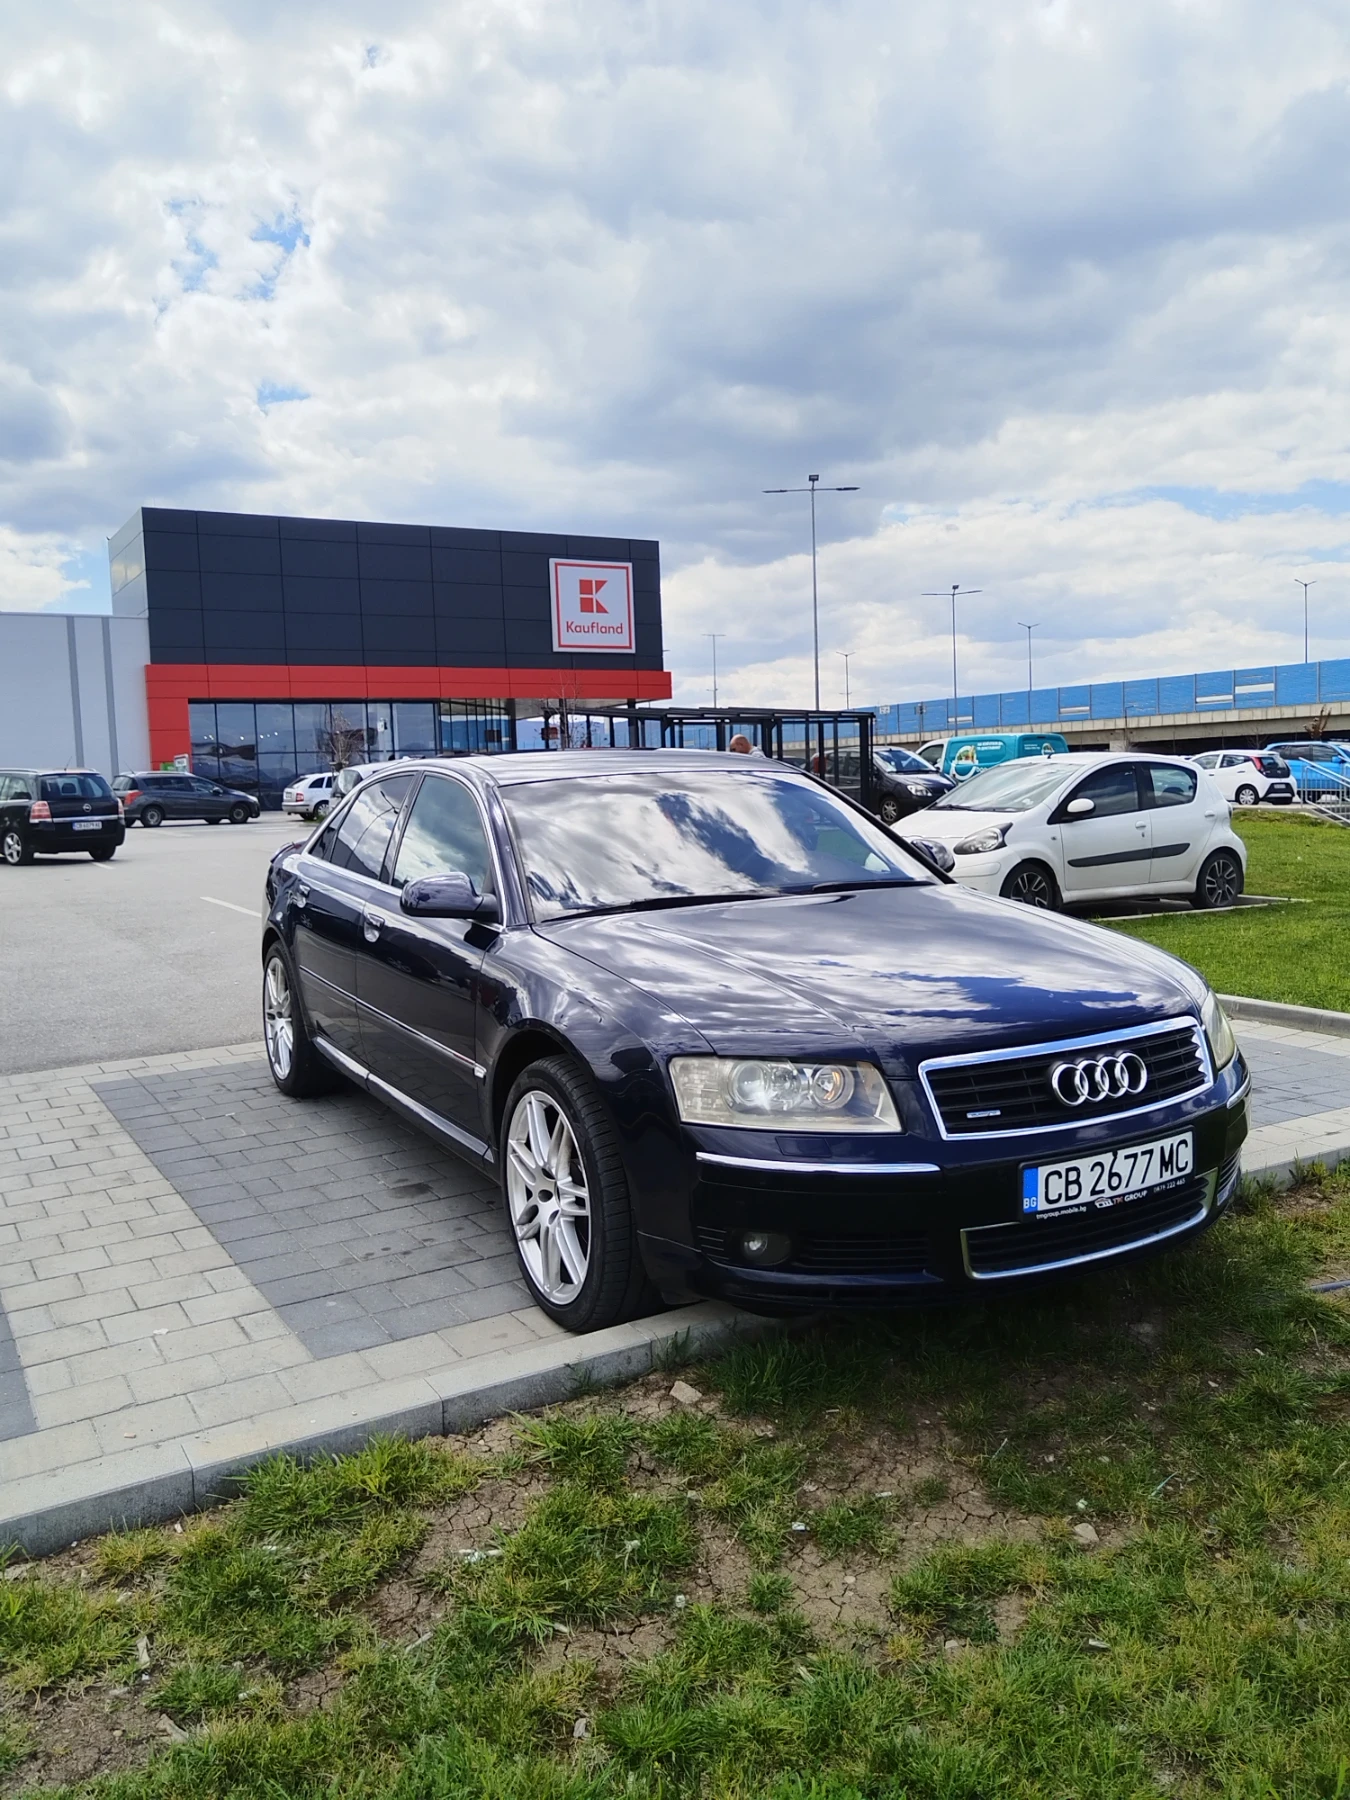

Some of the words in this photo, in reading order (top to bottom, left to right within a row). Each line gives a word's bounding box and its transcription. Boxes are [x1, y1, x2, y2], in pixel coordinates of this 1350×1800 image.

[579, 579, 609, 614] K
[566, 621, 624, 635] Kaufland
[1044, 1166, 1083, 1204] CB
[1090, 1149, 1154, 1197] 2677
[1159, 1139, 1189, 1179] MC
[1023, 1196, 1037, 1209] BG
[1036, 1205, 1087, 1220] tmgroup.mobile.bg
[1124, 1190, 1148, 1202] GROUP
